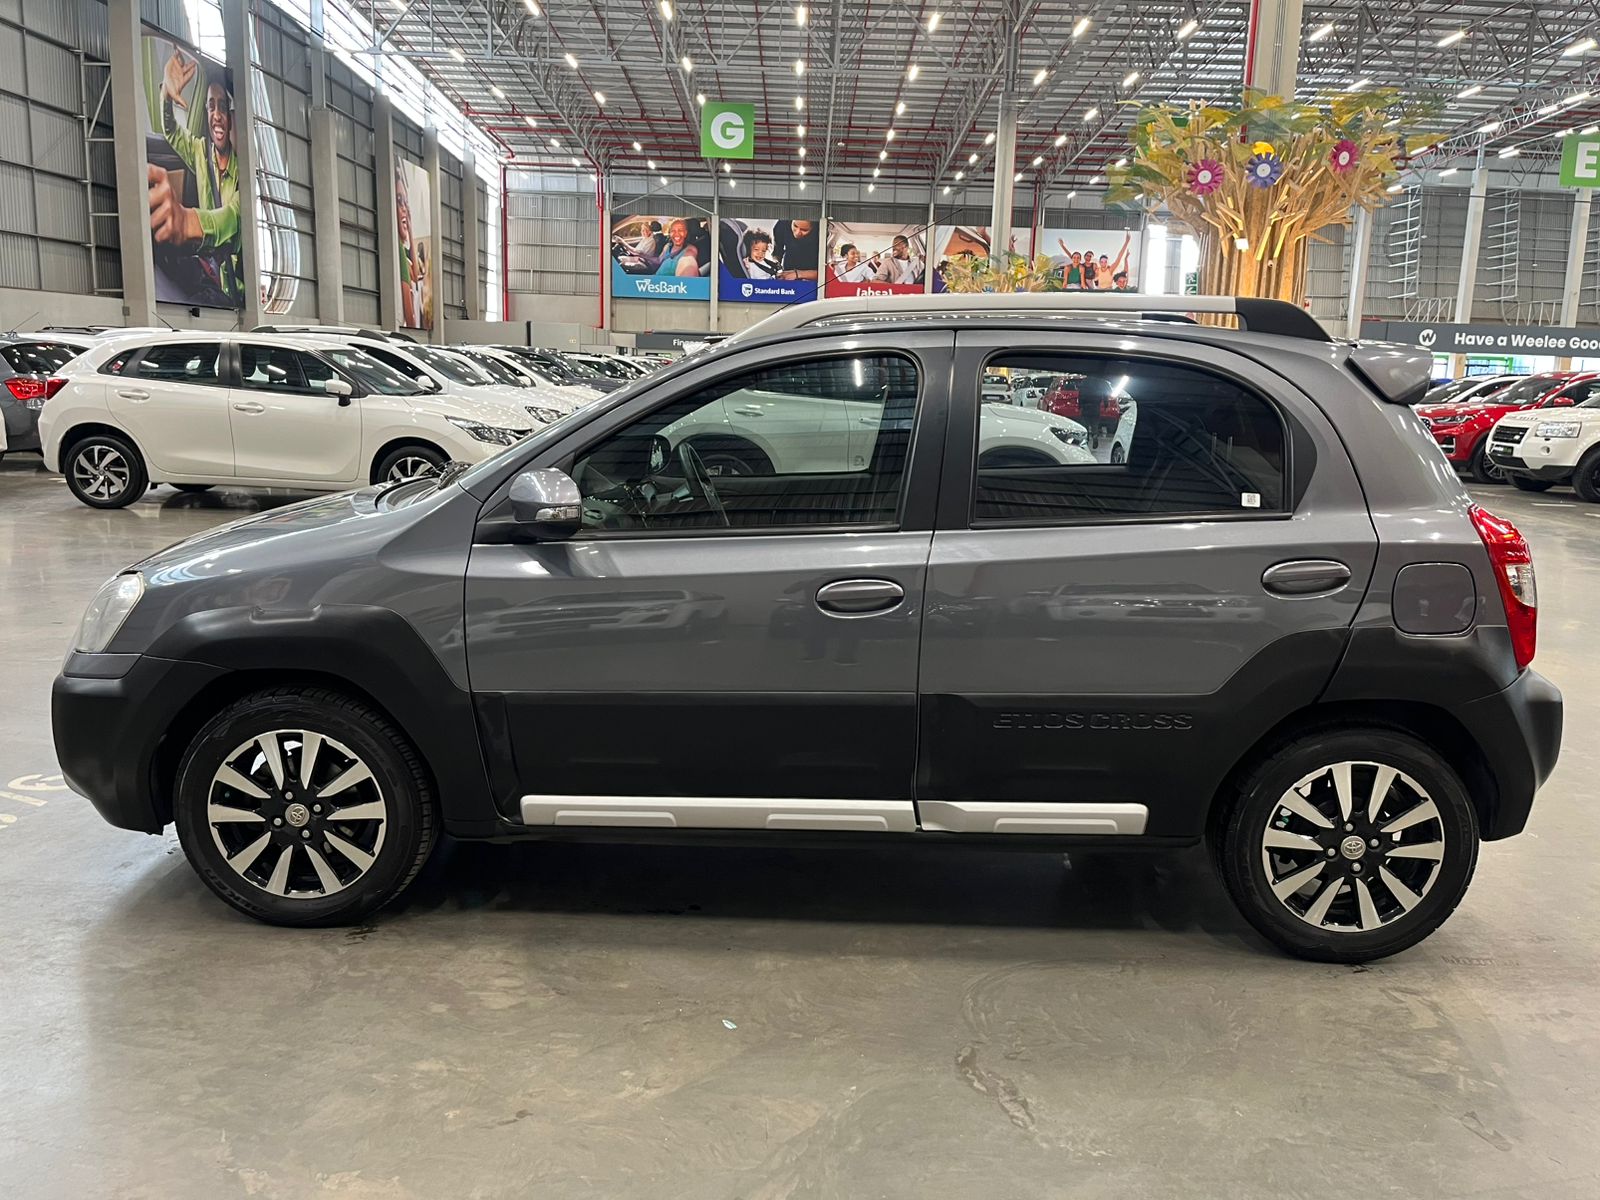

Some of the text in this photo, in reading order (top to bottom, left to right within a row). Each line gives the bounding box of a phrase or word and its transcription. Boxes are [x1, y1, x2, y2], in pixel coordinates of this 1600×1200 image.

[711, 112, 745, 149] G
[1575, 142, 1599, 178] E
[636, 279, 687, 294] WesBank
[754, 287, 780, 295] Standard
[1454, 332, 1600, 350] Have a Weelee Goo
[993, 713, 1193, 730] ETIOS CROSS
